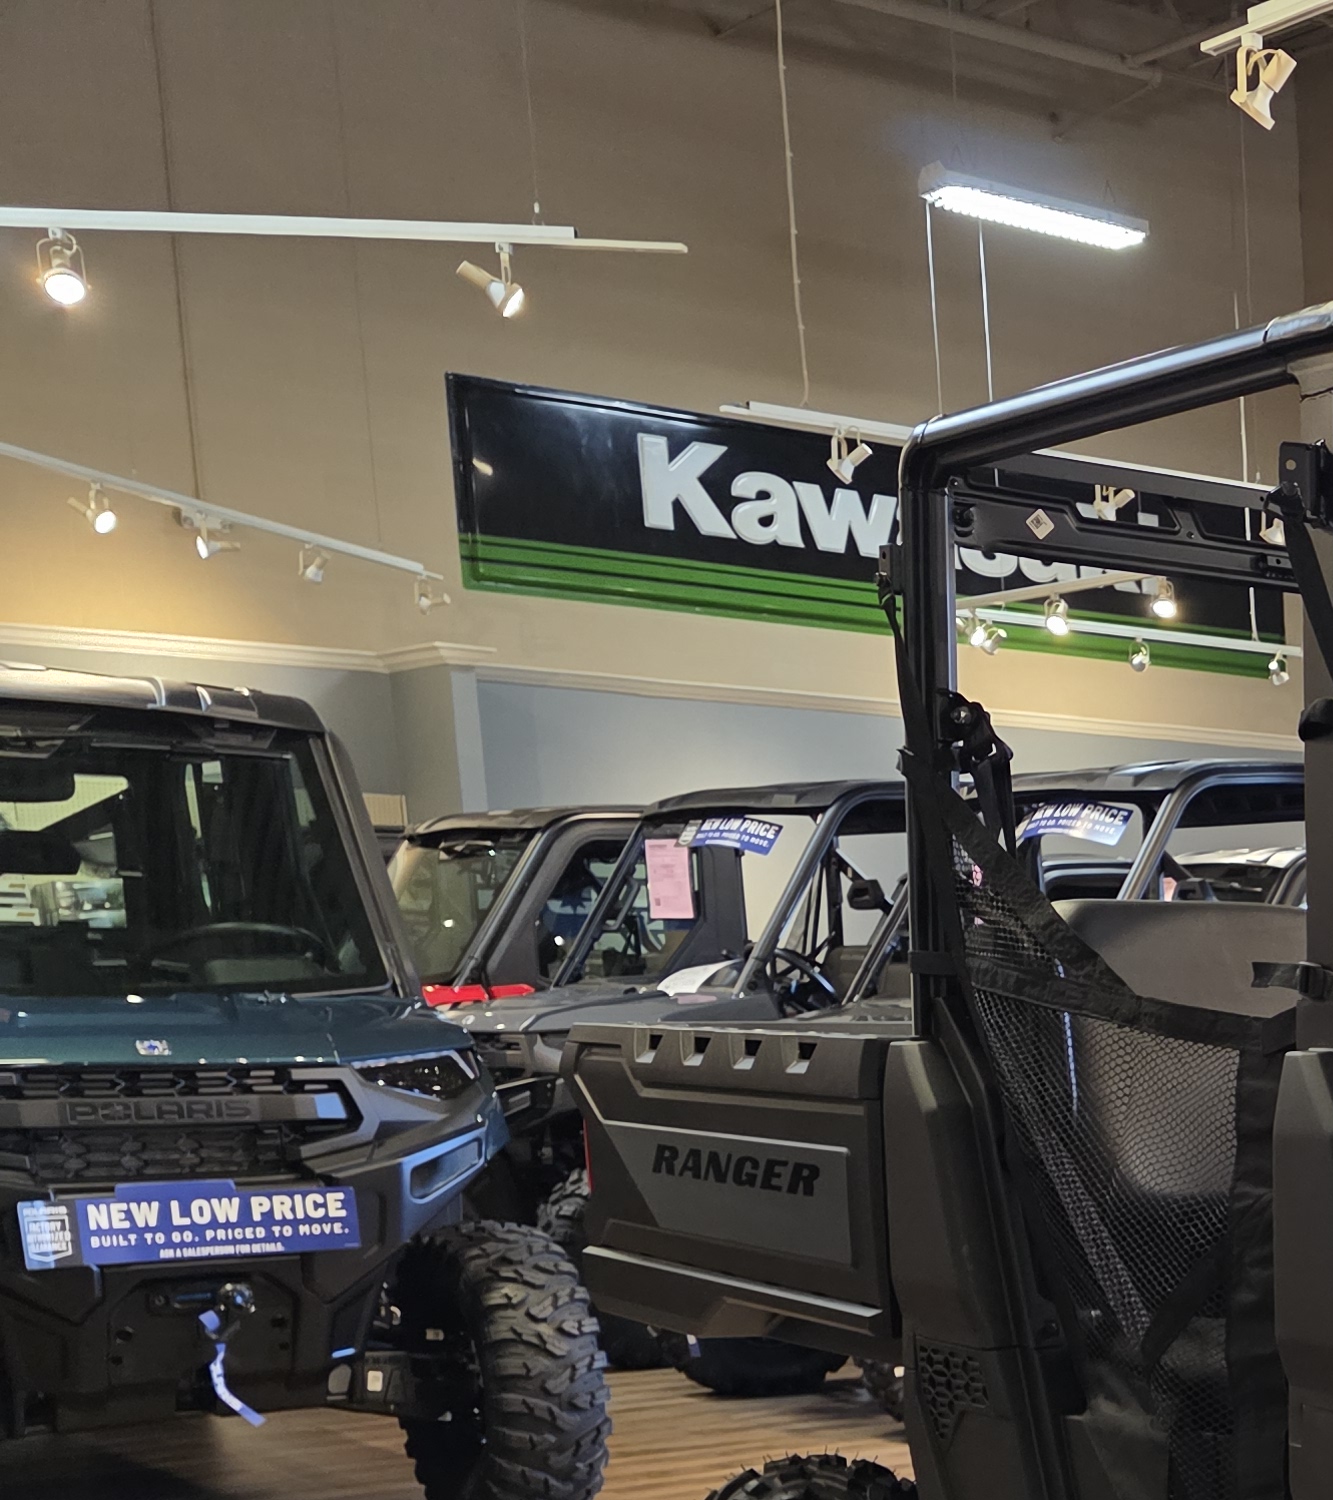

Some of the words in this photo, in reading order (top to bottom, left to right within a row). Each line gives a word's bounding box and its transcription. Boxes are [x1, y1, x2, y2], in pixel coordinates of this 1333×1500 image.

[1054, 802, 1084, 818] LOW
[1081, 804, 1129, 826] PRICE
[719, 817, 743, 831] LOW
[740, 819, 779, 839] PRICE
[66, 1099, 252, 1125] POLARIS
[652, 1143, 821, 1197] RANGER
[86, 1201, 160, 1231] NEW
[170, 1196, 241, 1226] LOW
[250, 1192, 348, 1222] PRICE
[90, 1233, 137, 1249] BUILT
[144, 1232, 166, 1246] TO
[205, 1226, 266, 1243] PRICED
[272, 1225, 293, 1239] TO
[299, 1221, 351, 1238] MOVE.
